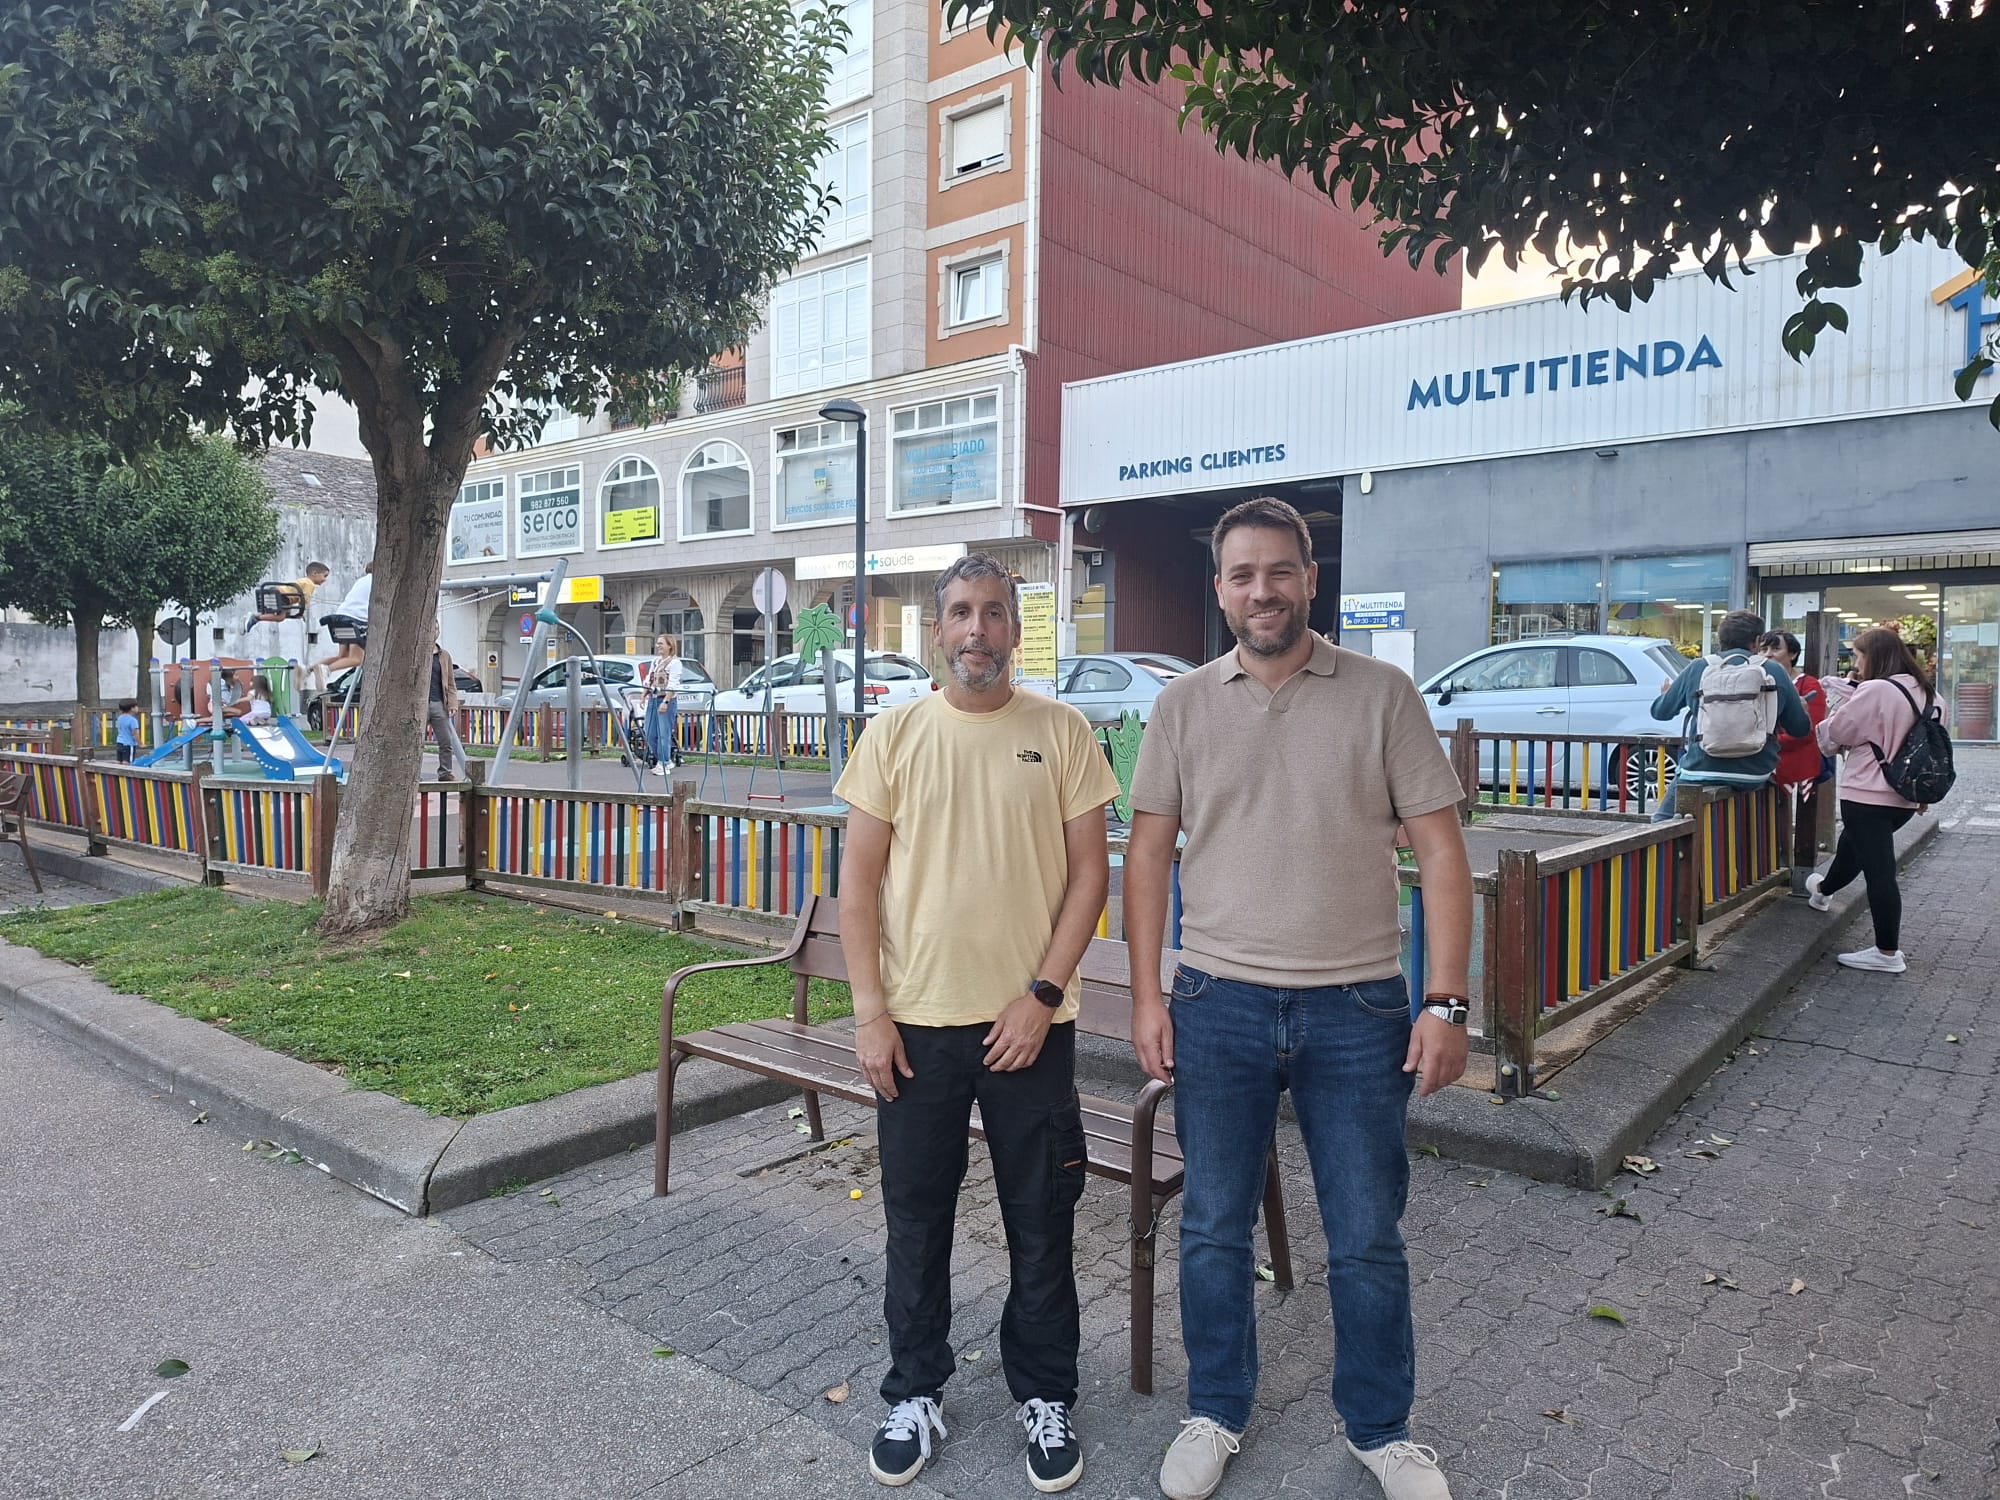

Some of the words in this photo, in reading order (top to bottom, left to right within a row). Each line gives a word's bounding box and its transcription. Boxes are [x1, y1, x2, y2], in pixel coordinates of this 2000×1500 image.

[1407, 334, 1723, 411] MULTITIENDA
[1119, 457, 1192, 481] PARKING
[1200, 443, 1286, 470] CLIENTES
[530, 500, 542, 510] 982
[556, 495, 569, 506] 560
[523, 508, 578, 534] serco
[879, 553, 914, 568] saúde
[1360, 601, 1403, 610] MULTITIENDA
[1390, 616, 1400, 626] P
